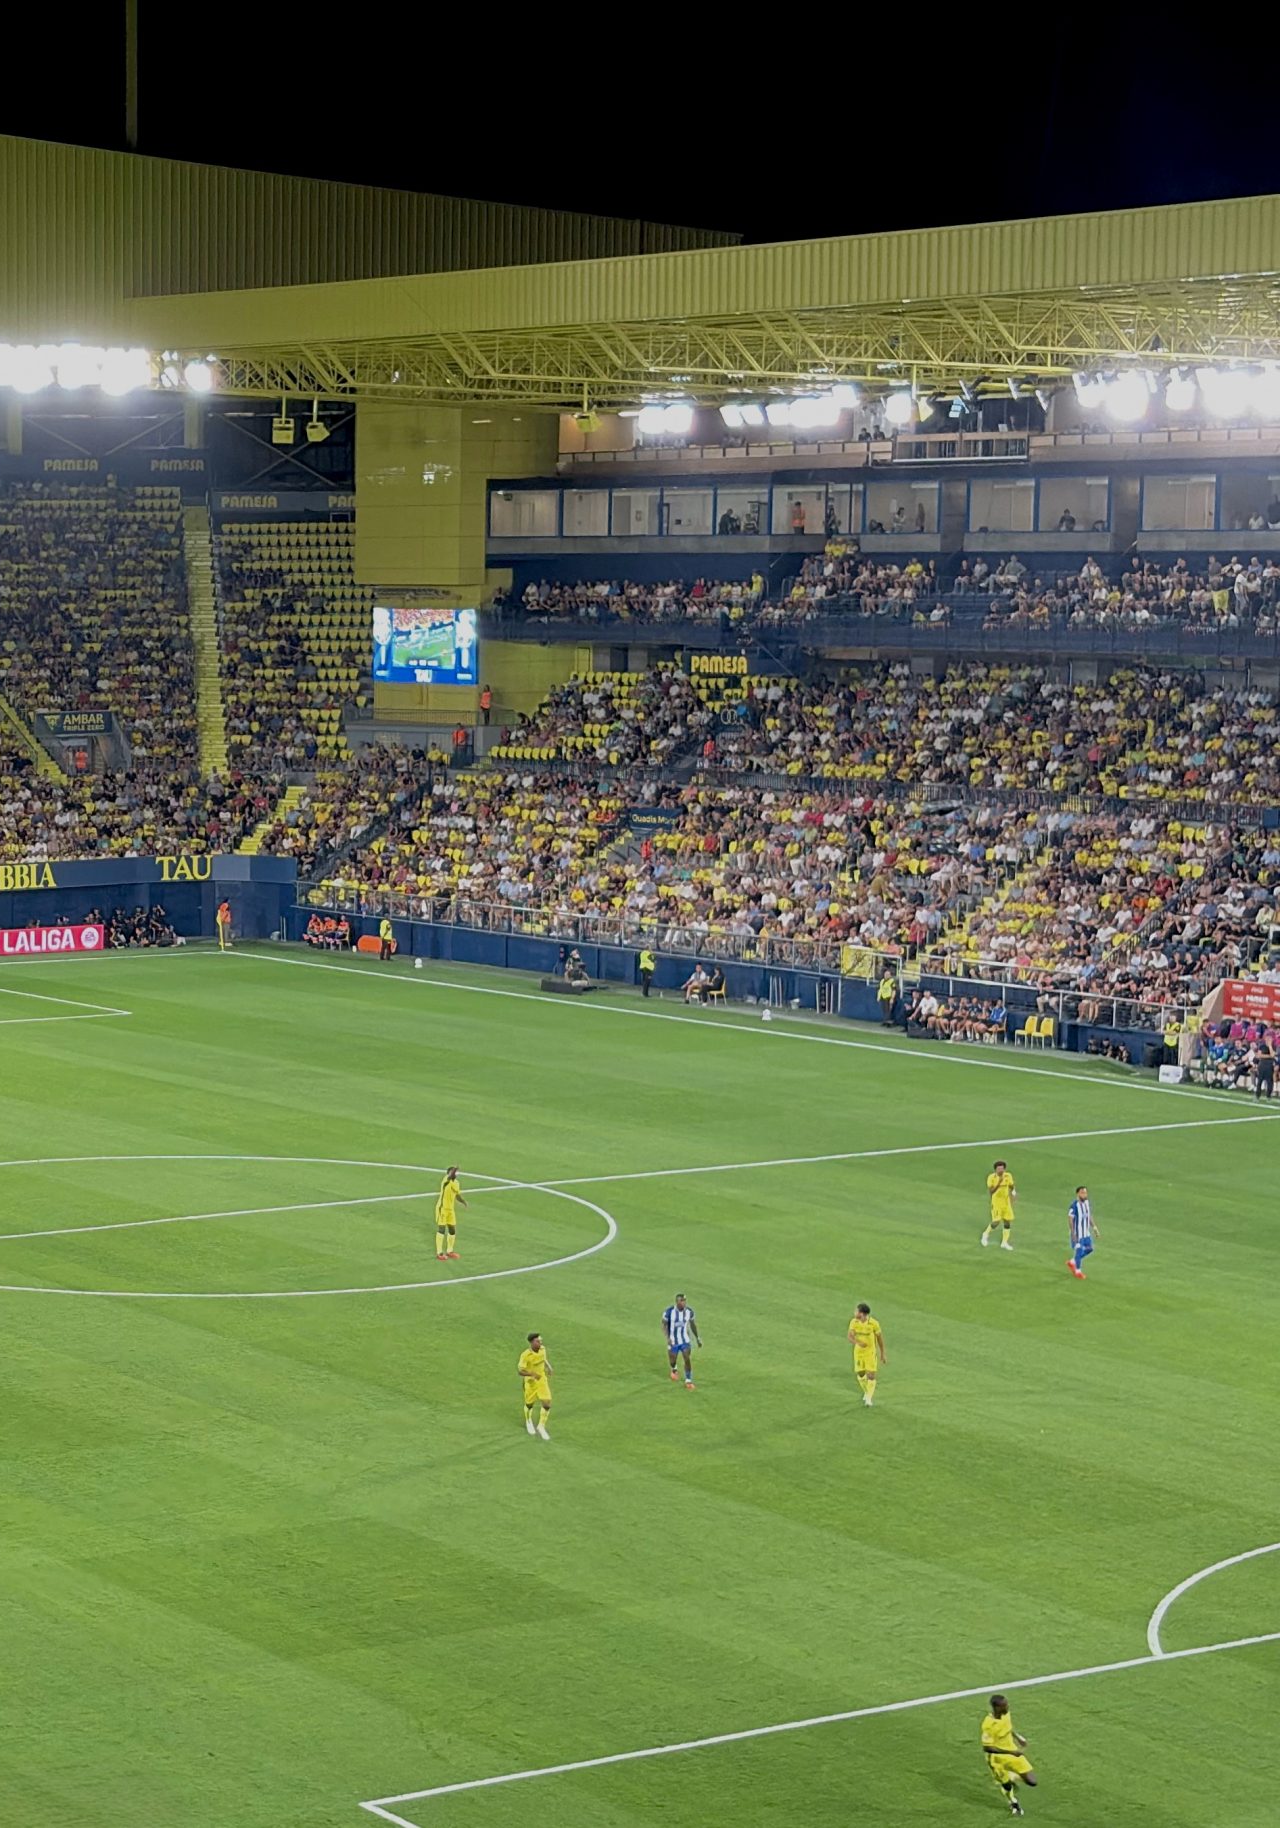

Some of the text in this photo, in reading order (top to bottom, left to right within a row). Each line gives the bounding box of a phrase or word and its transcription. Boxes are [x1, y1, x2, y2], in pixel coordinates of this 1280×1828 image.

[43, 459, 99, 471] PAMESA
[150, 459, 205, 471] PAMESA
[221, 496, 277, 508] PAMESA
[691, 655, 748, 674] PAMESA
[64, 713, 104, 725] AMBAR
[155, 855, 214, 881] TAU
[3, 928, 76, 953] LALIGA
